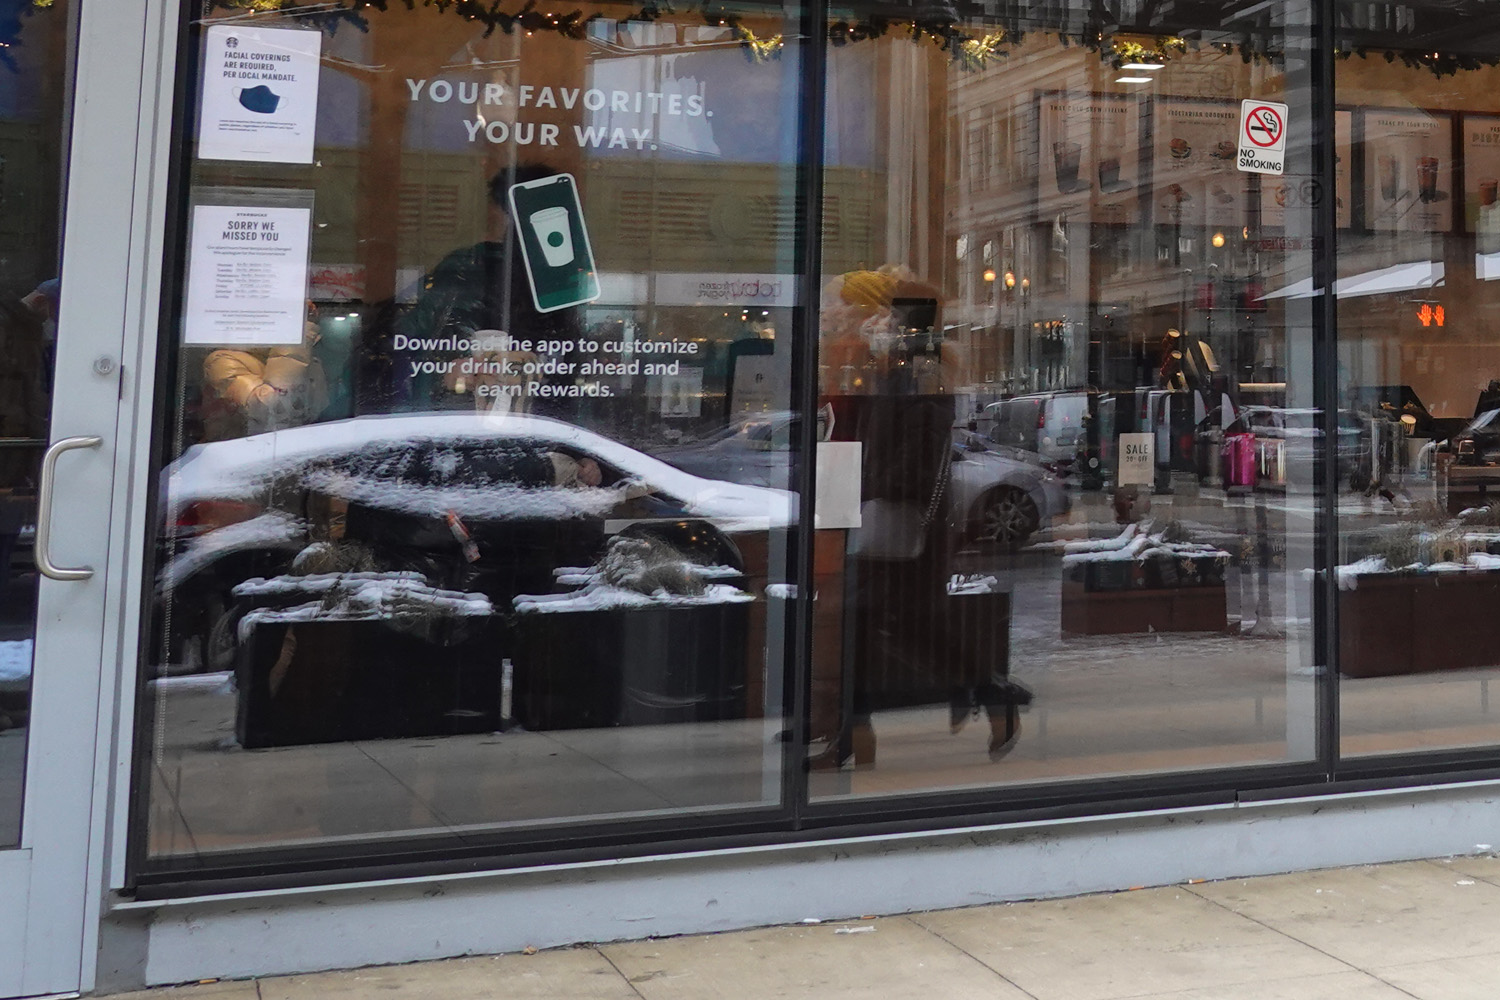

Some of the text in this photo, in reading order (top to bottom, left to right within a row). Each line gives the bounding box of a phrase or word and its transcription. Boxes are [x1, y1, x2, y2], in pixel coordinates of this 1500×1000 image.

[224, 51, 291, 62] FACIAL COVERINGS
[224, 61, 277, 72] ARE REQUIRED,
[223, 71, 297, 82] PER LOCAL MANDATE.
[406, 78, 714, 118] YOUR FAVORITES.
[463, 119, 658, 151] YOUR WAY.
[1240, 149, 1255, 158] NO
[1239, 158, 1282, 171] SMOKING
[227, 220, 276, 231] SORRY WE
[222, 231, 279, 242] MISSED YOU
[394, 334, 699, 356] Download the app to customize
[410, 358, 680, 379] your drink, order ahead and
[477, 382, 615, 398] earn Rewards.
[1126, 444, 1148, 455] SALE
